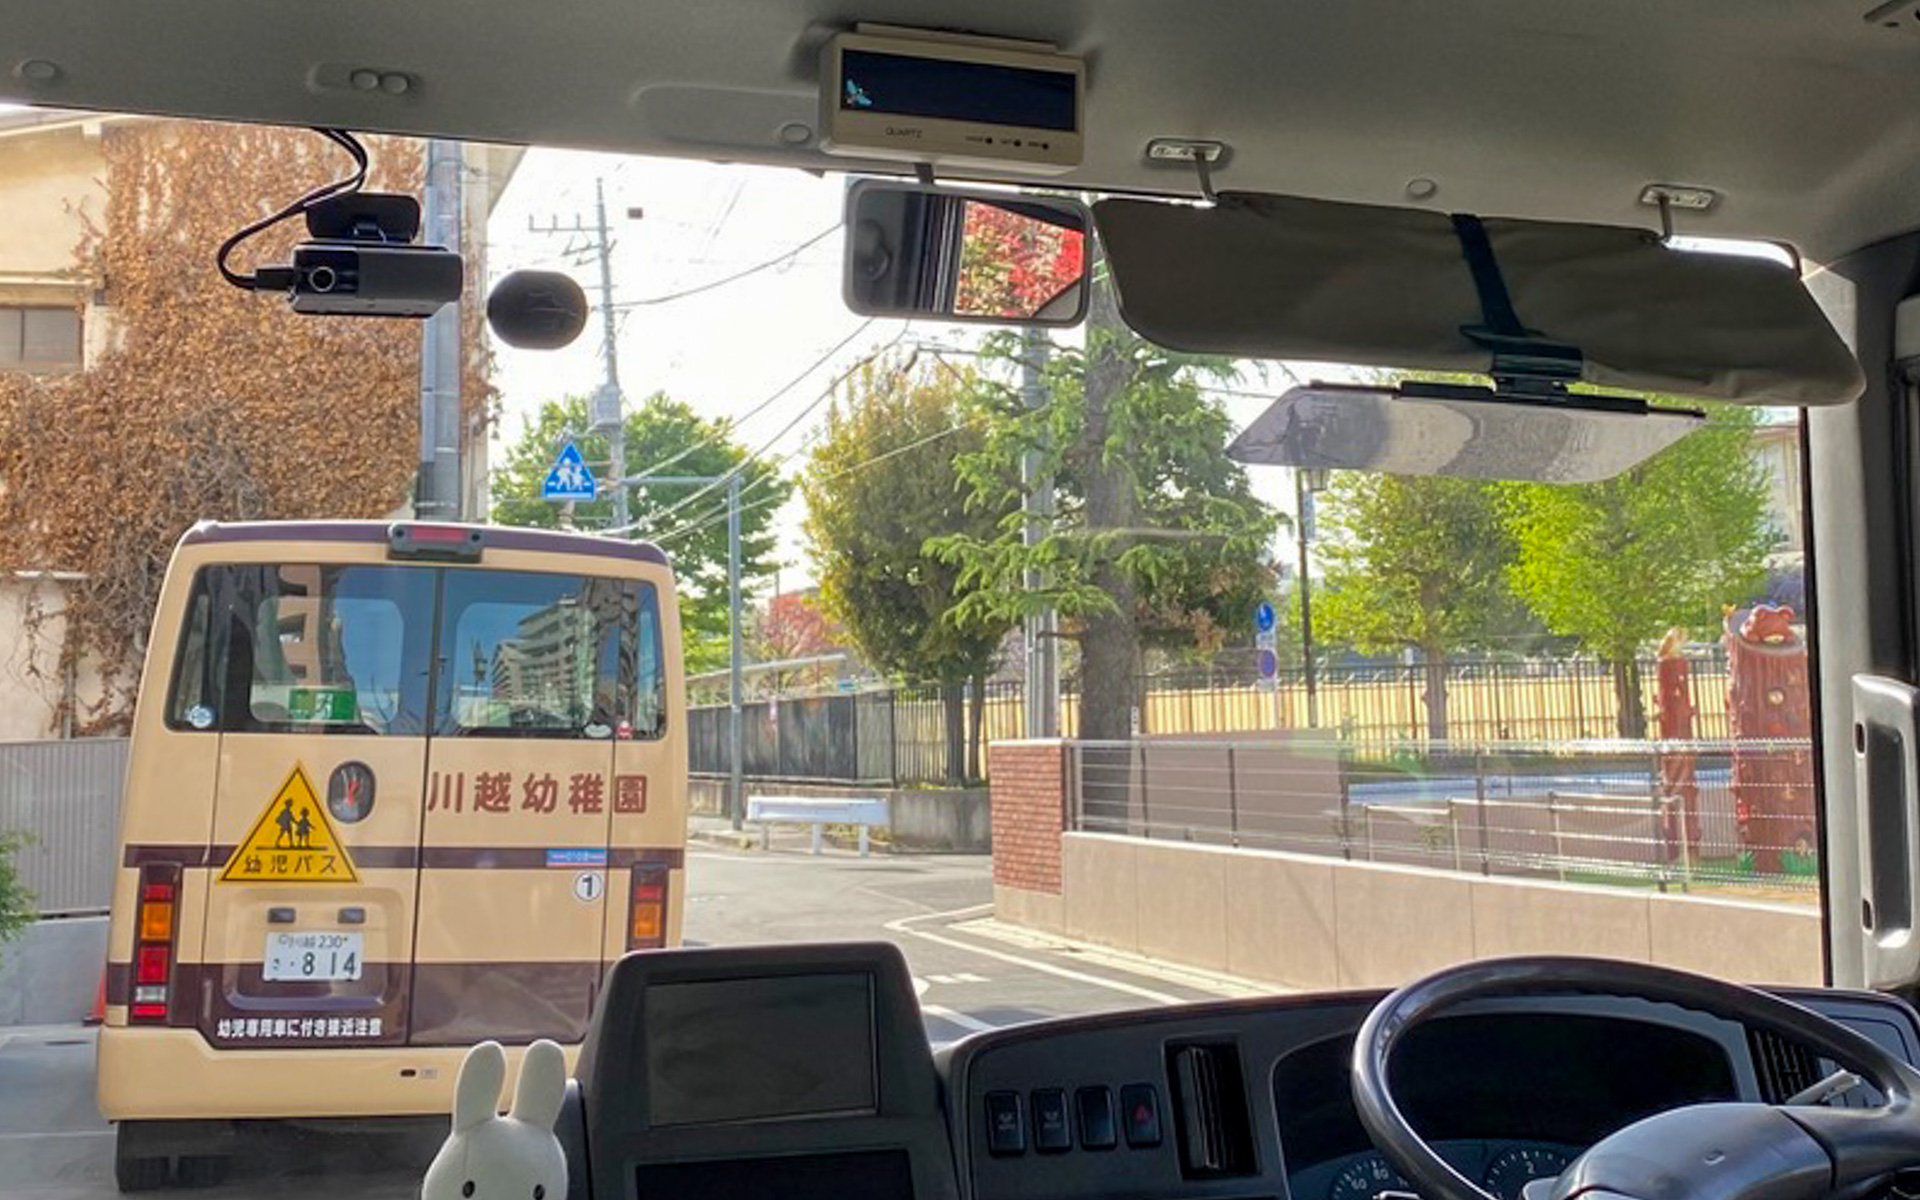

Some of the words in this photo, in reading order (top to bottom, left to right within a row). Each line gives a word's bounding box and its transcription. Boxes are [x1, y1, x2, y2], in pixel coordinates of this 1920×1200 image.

[885, 126, 922, 138] QUARTZ
[428, 771, 647, 814] 川越幼稚園
[242, 854, 338, 874] 幼児バス
